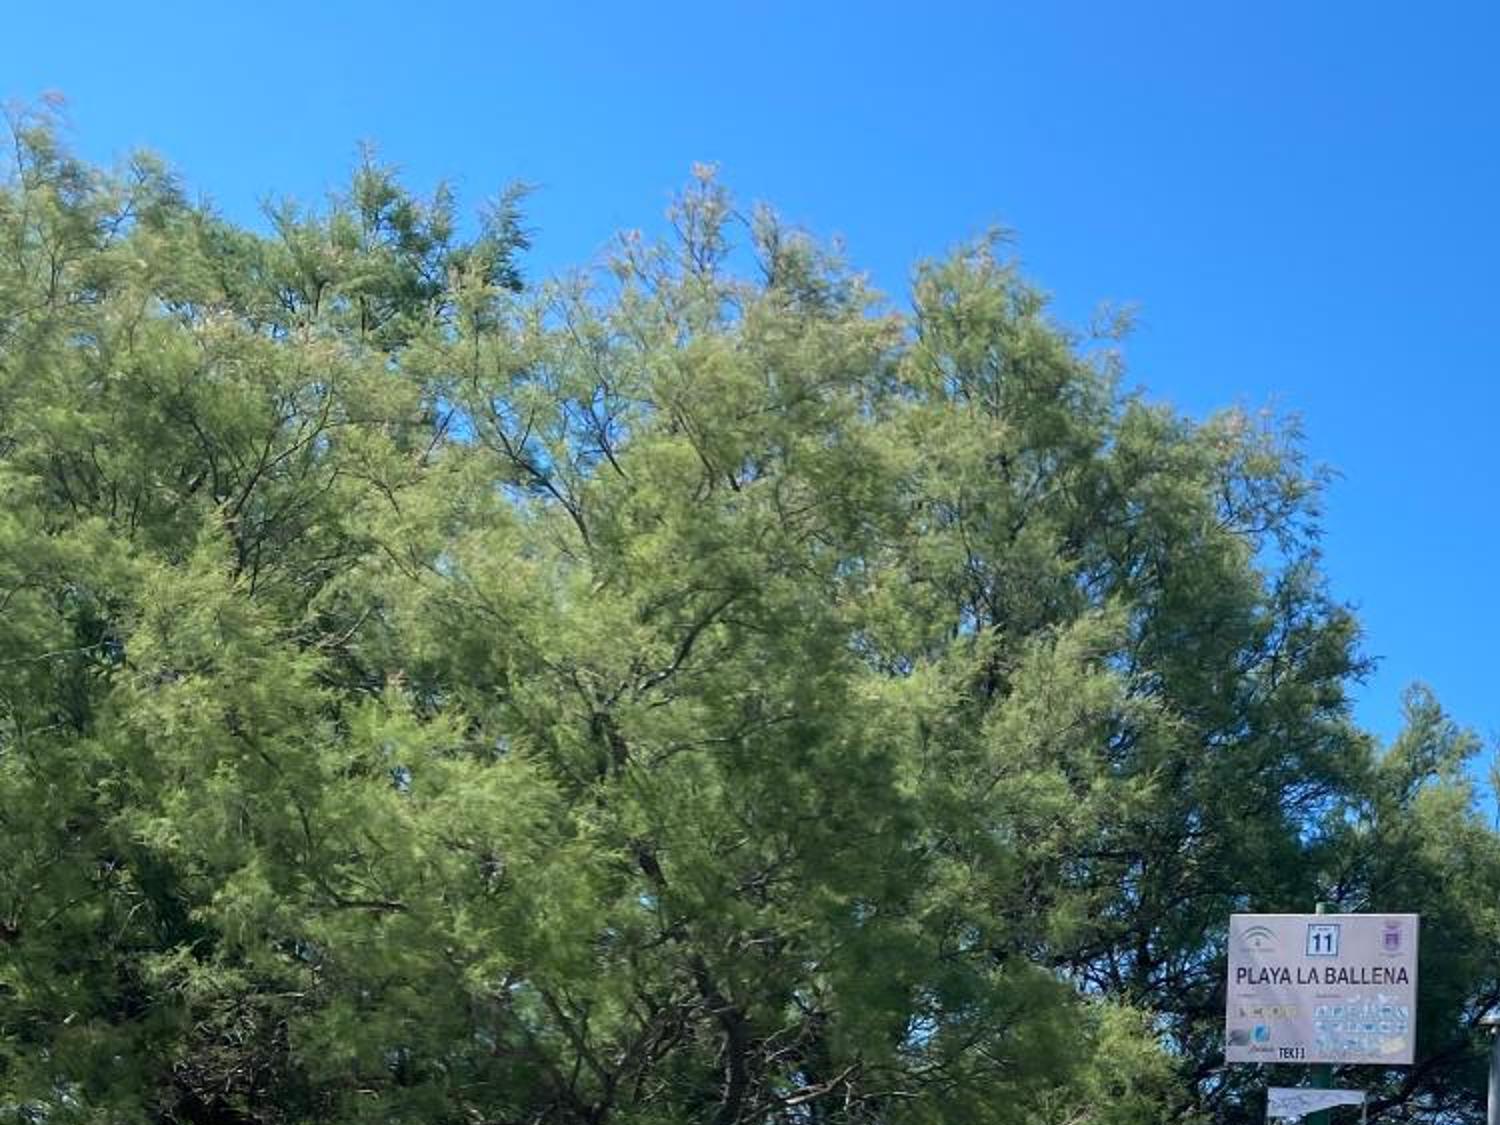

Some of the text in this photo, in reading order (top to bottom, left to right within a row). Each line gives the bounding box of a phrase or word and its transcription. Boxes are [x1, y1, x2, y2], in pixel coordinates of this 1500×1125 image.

[1312, 933, 1331, 952] 11
[1236, 967, 1409, 985] PLAYA LA BALLENA
